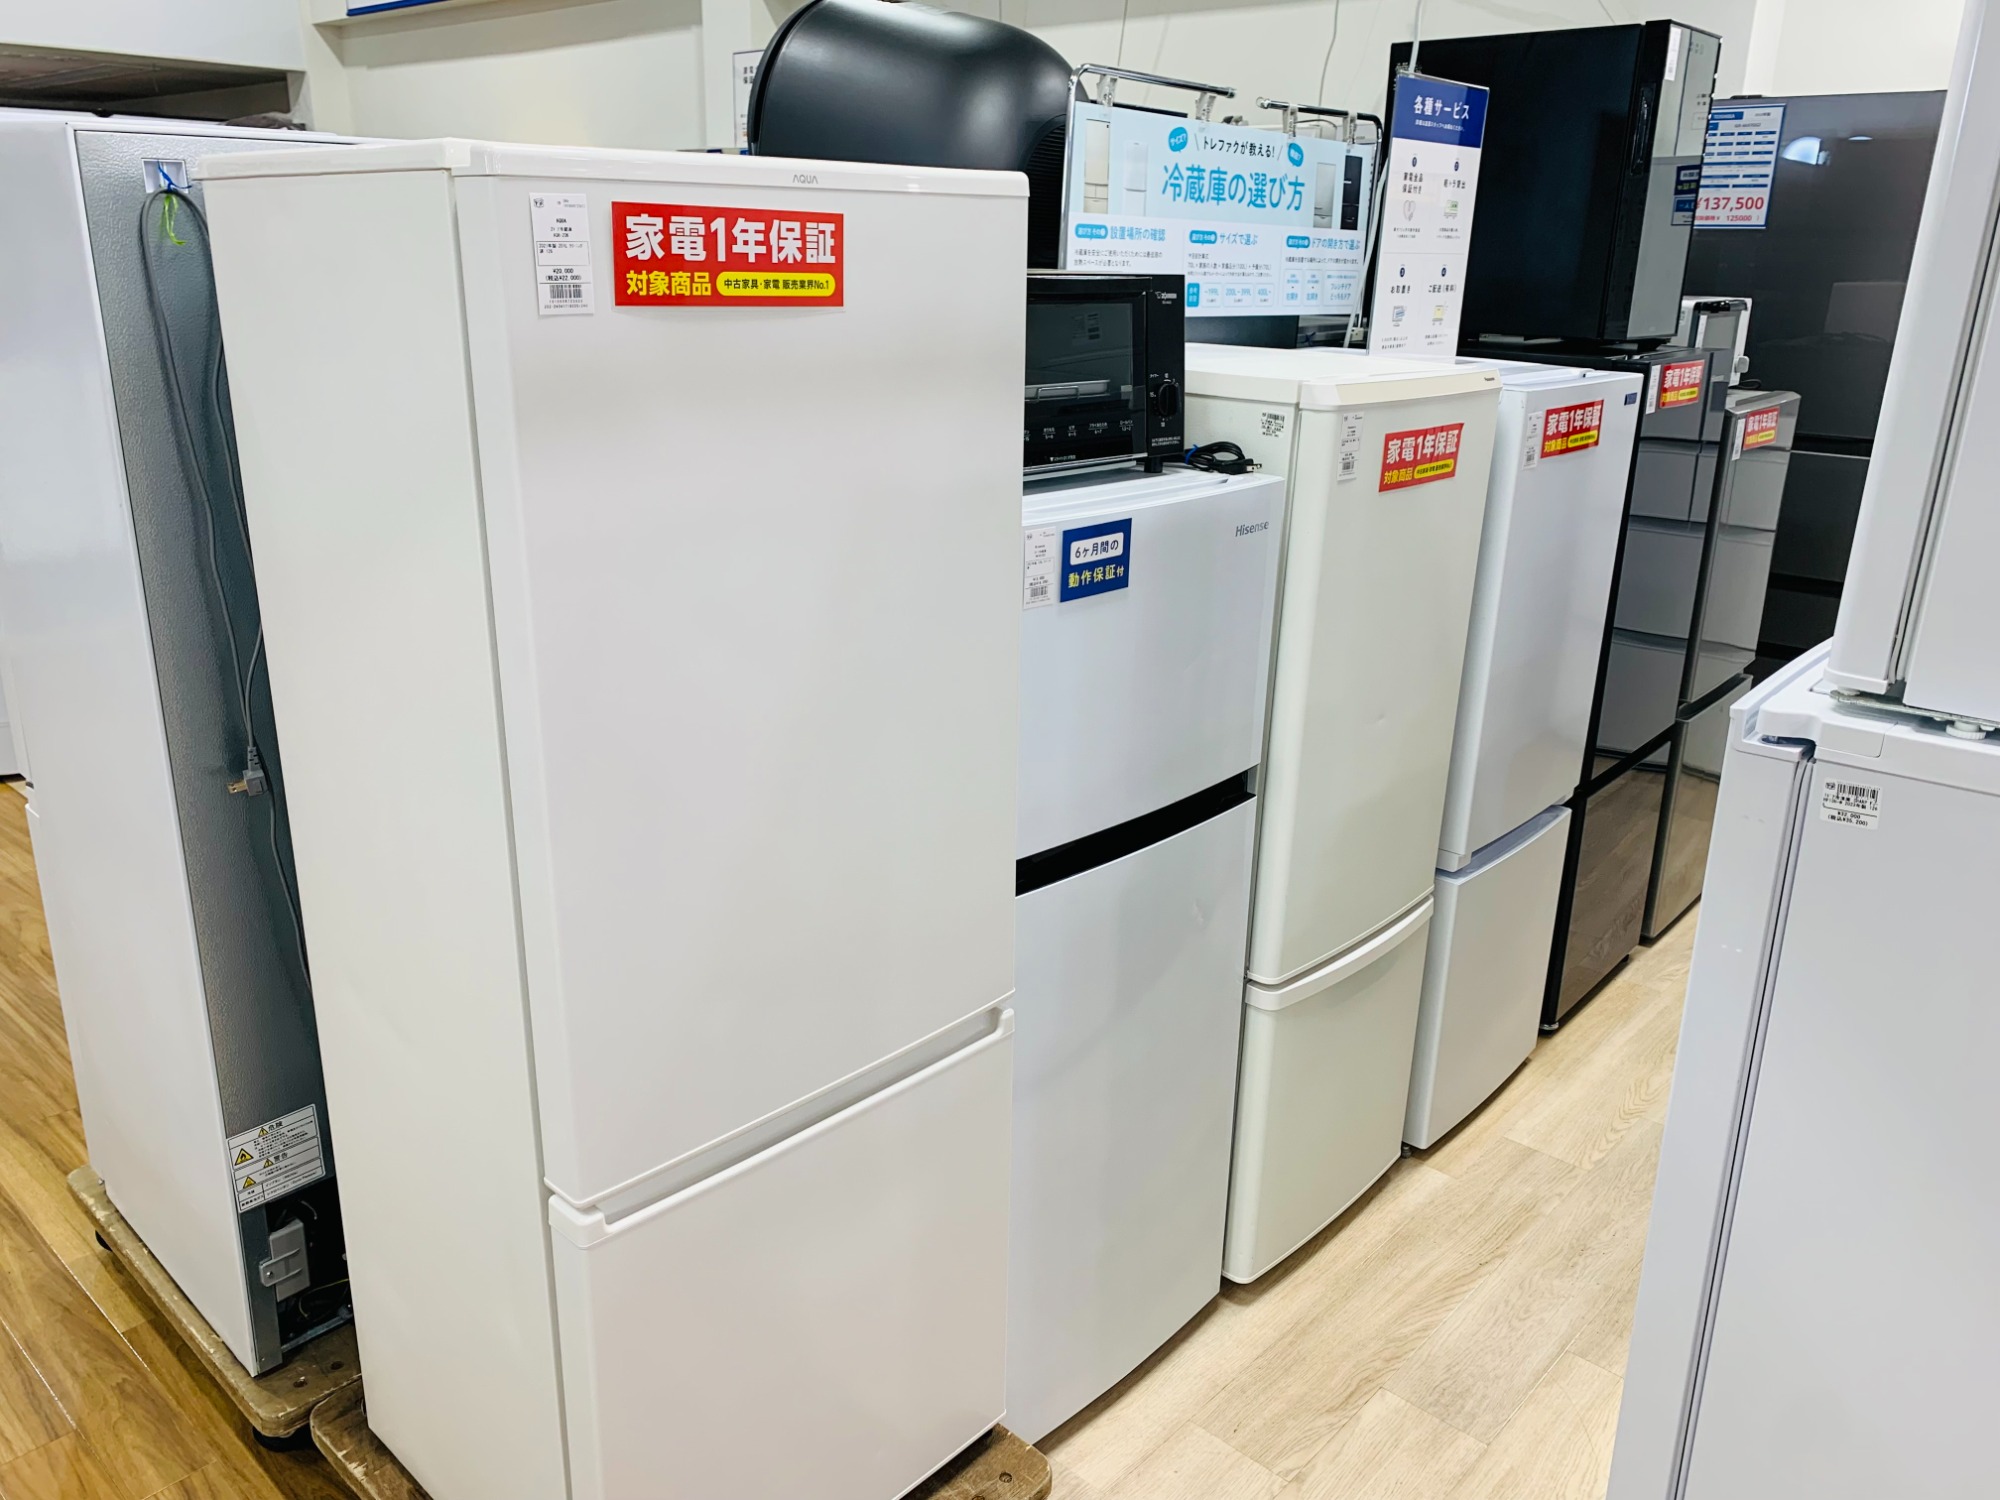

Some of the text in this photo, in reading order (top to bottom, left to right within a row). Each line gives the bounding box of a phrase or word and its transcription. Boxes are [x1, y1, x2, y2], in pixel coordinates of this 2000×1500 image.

[1413, 95, 1470, 120] 各種サービス
[792, 174, 819, 185] AQUA
[1162, 163, 1305, 211] 冷蔵庫の選び方
[625, 213, 836, 264] 家電1年保証
[1110, 226, 1166, 241] 設置場所の確認
[1220, 233, 1259, 246] サイズで選ぶ
[626, 270, 712, 296] 対象商品
[724, 278, 781, 291] 中古家具・家電
[1546, 404, 1602, 436] 家電1年保証
[1386, 429, 1460, 465] 家電1年保証
[1383, 467, 1414, 485] 対象商品
[1235, 521, 1269, 537] Hisense
[1068, 564, 1124, 589] 動作保証付
